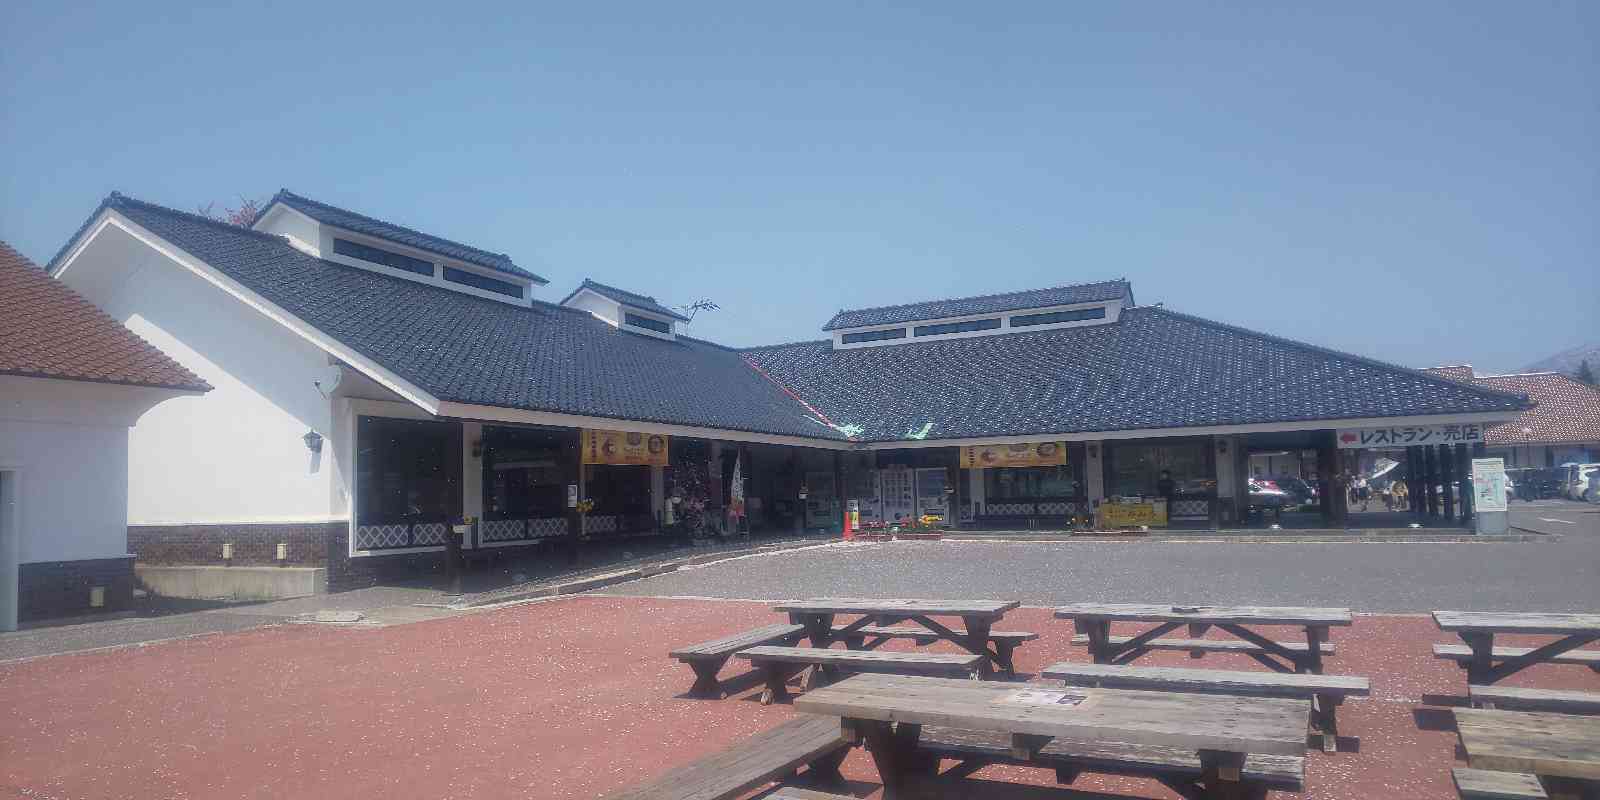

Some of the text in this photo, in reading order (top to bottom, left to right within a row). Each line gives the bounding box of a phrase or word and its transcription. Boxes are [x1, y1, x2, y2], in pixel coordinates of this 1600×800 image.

[1360, 424, 1480, 444] レストラン・売店
